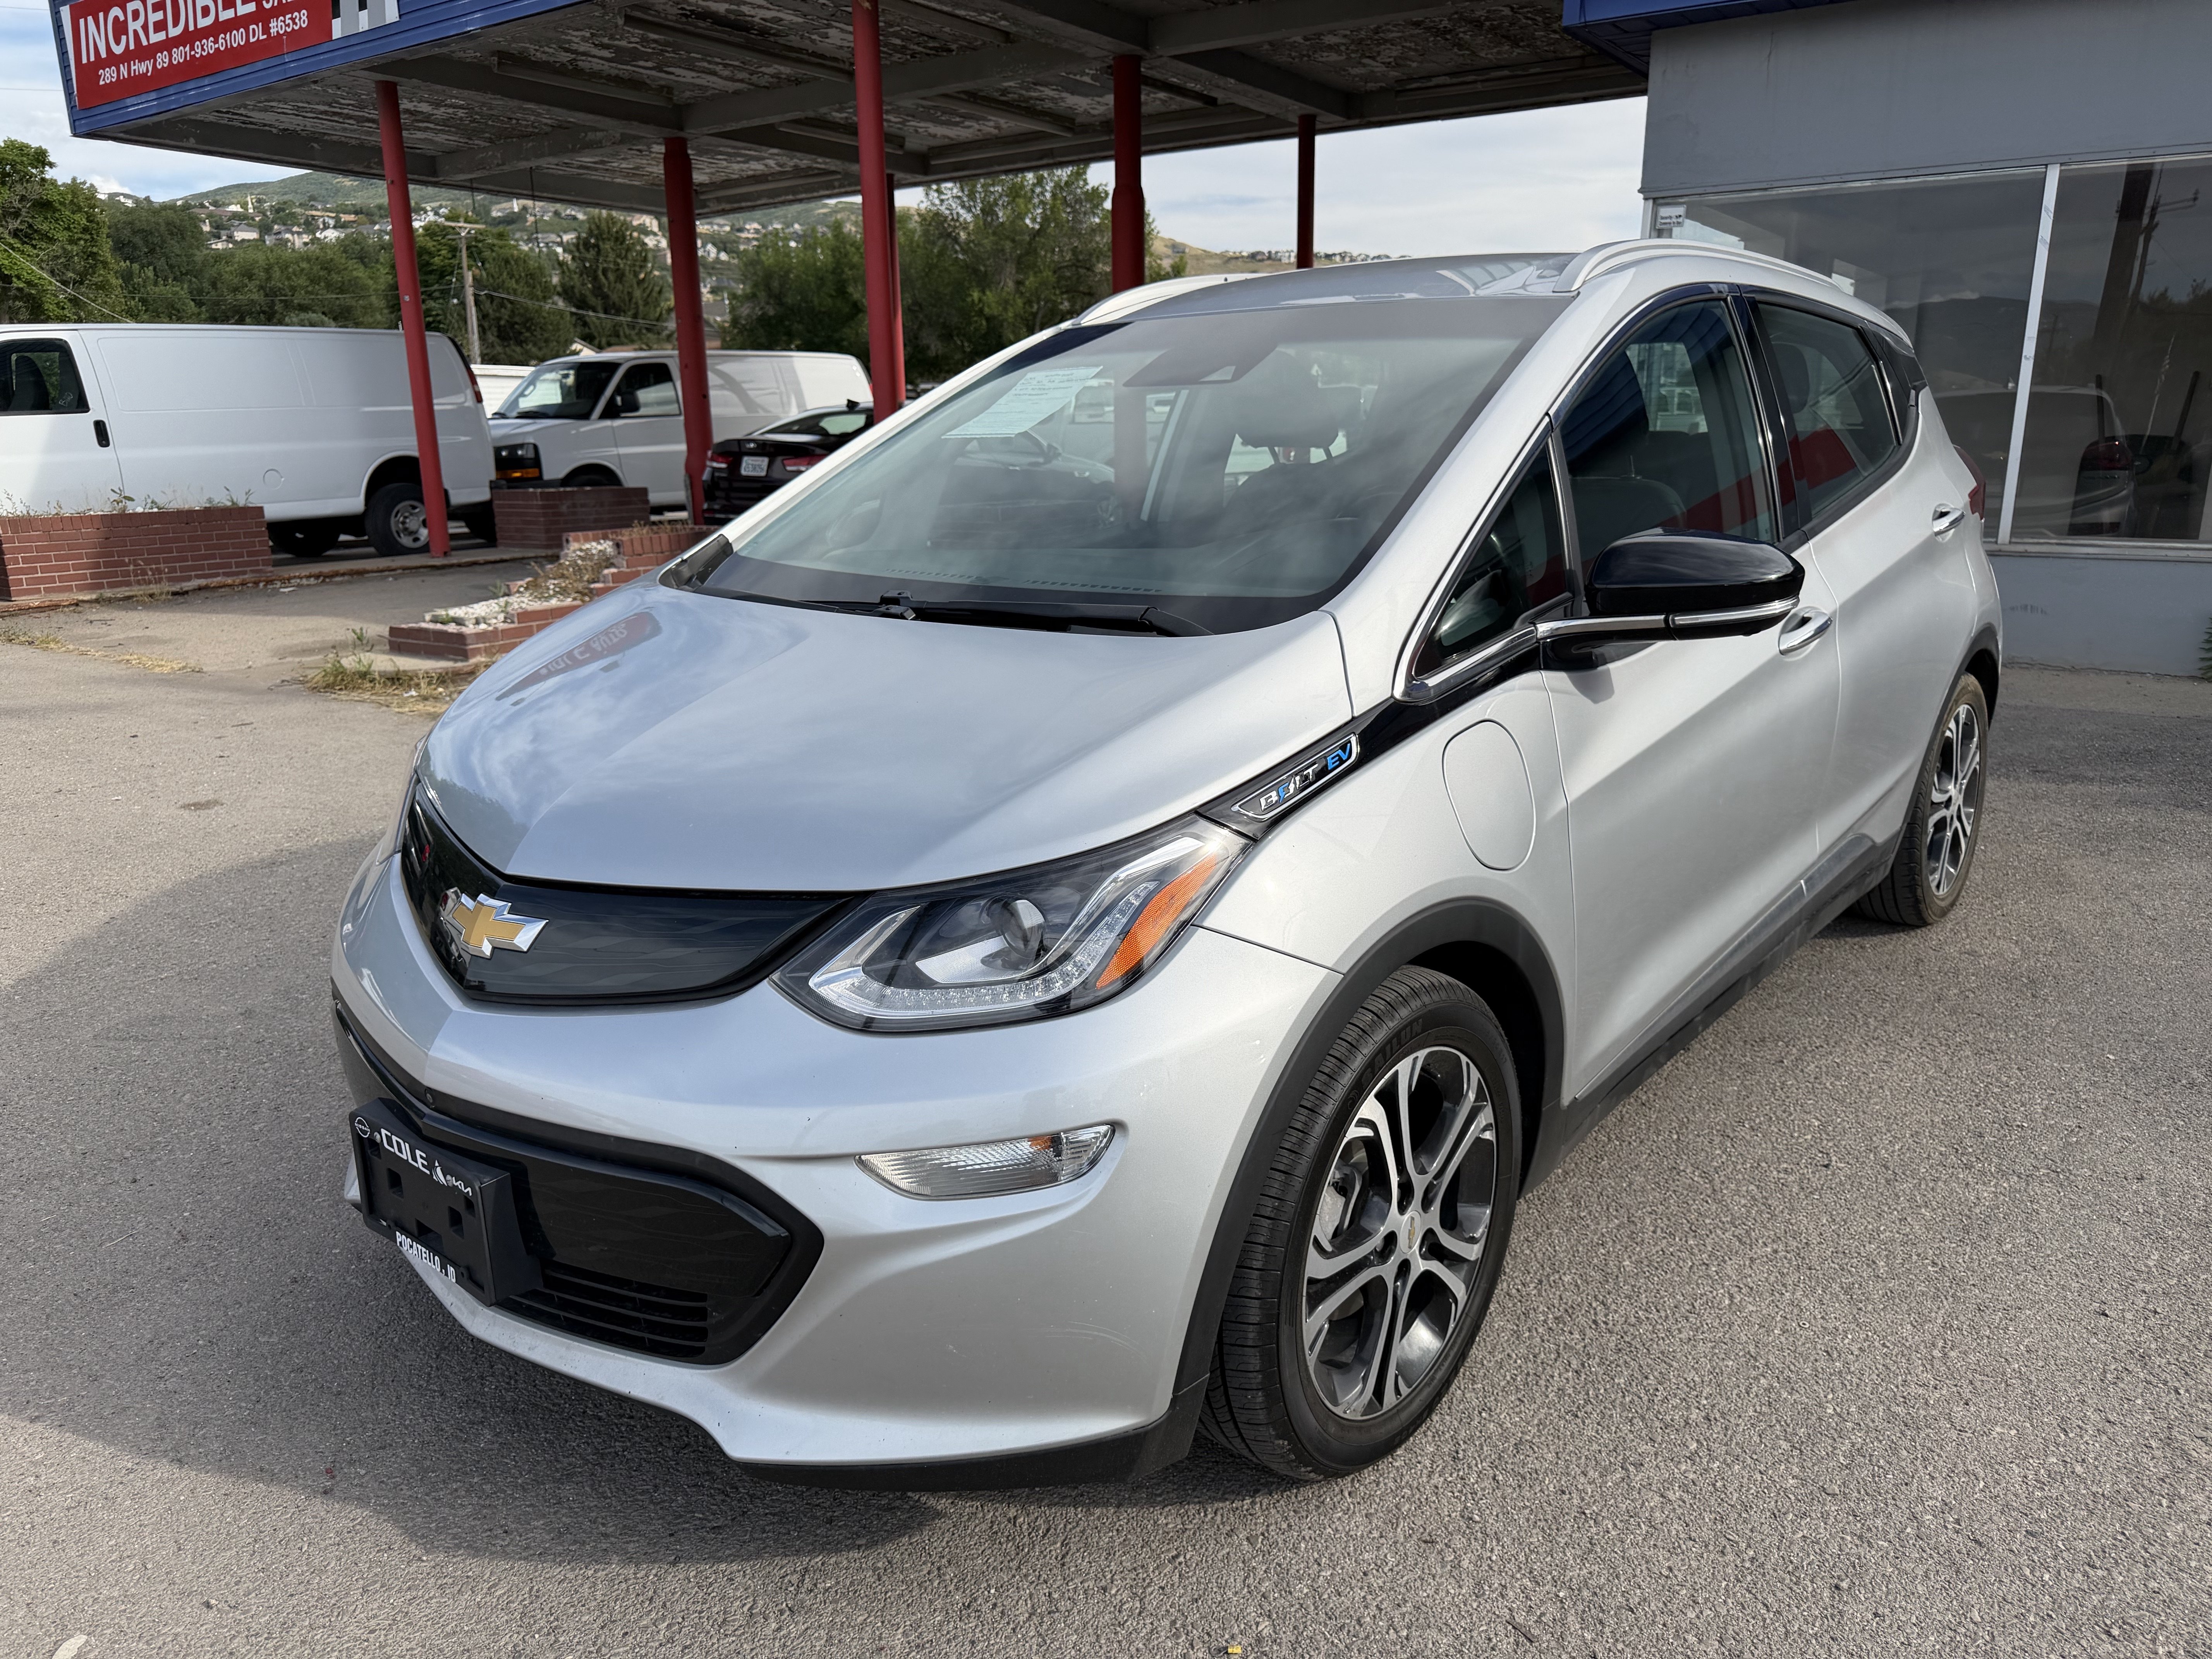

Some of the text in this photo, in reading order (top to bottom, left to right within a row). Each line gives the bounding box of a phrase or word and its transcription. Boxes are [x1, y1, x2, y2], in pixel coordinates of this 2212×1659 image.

[99, 10, 308, 85] 289 N Hwy 89 801-936-6100 DL #6538
[1259, 743, 1351, 811] BOLT EV
[1360, 1018, 1424, 1088] SAILUN
[355, 1122, 371, 1132] NISSAN
[381, 1128, 430, 1175] COLE
[447, 1264, 456, 1283] ID
